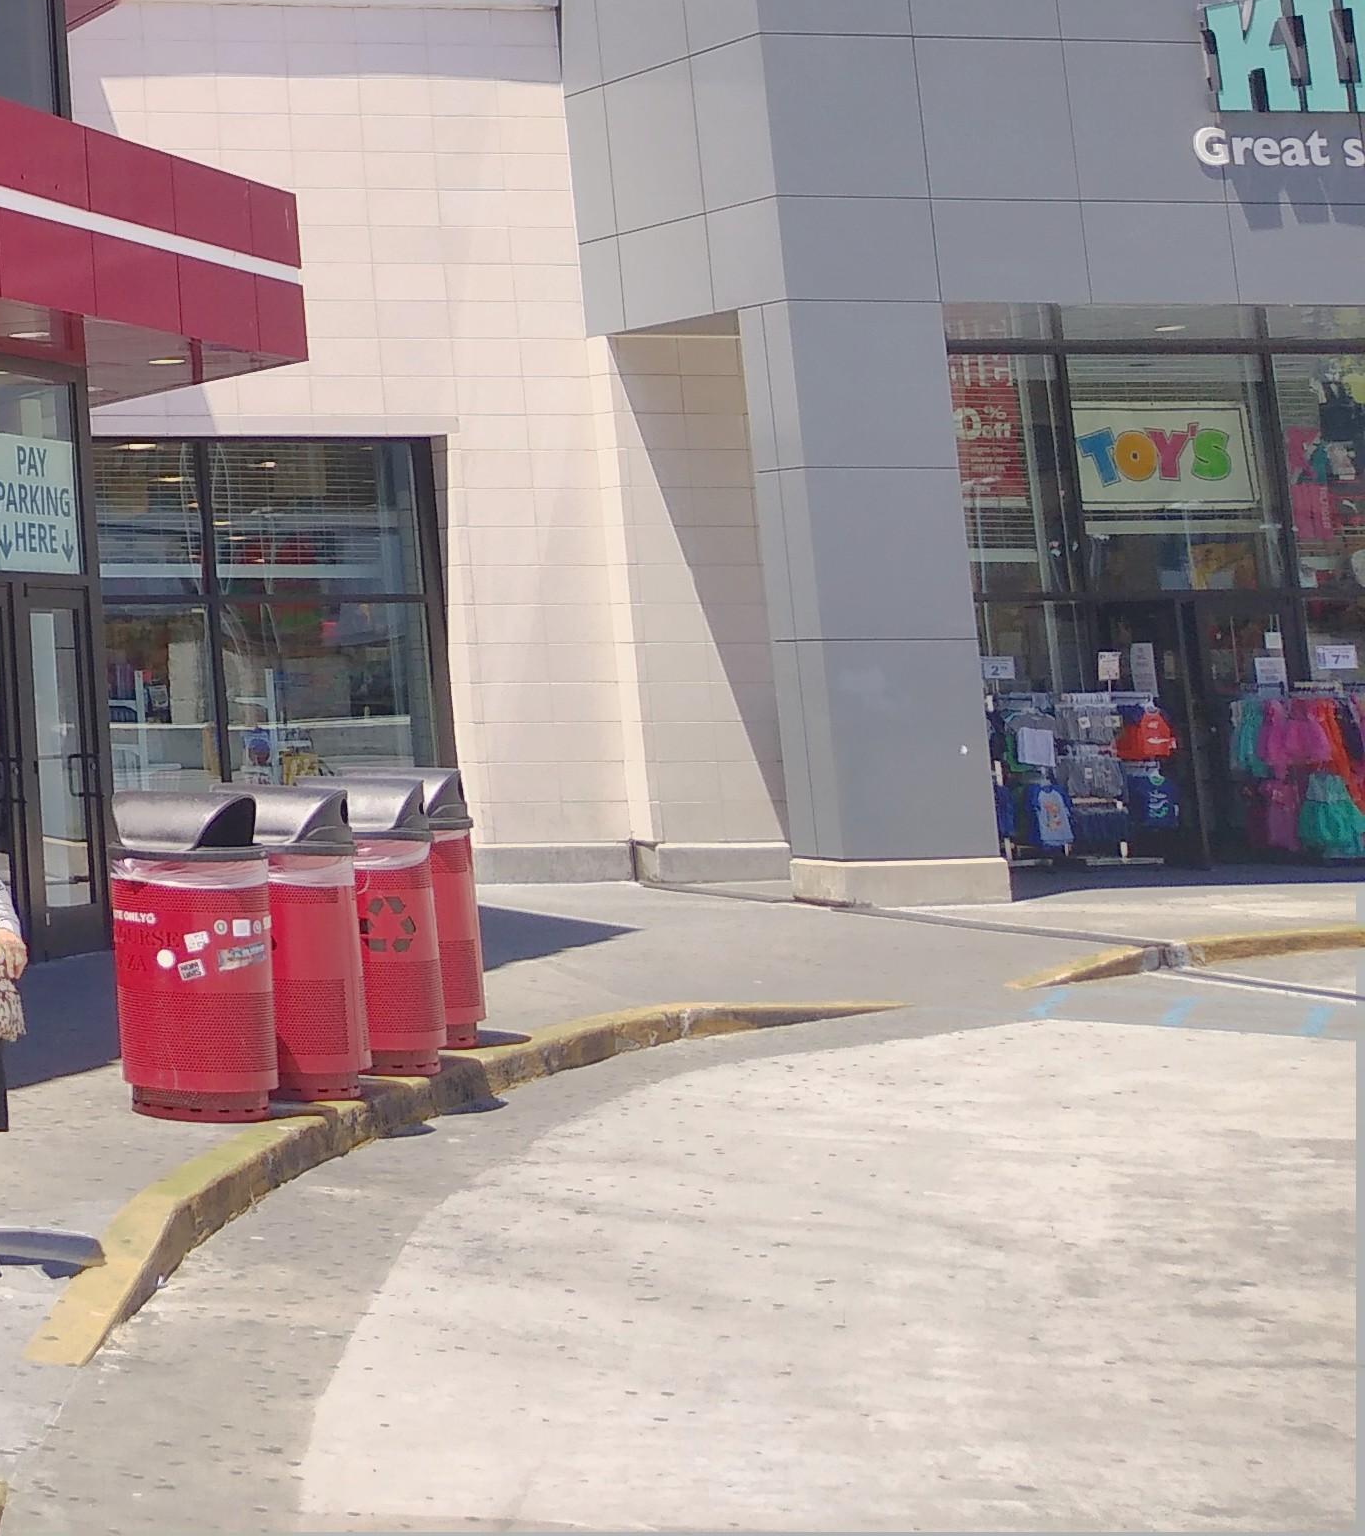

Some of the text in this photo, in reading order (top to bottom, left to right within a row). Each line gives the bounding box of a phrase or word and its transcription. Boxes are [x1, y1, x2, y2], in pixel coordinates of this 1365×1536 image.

[1193, 126, 1330, 166] Great
[16, 445, 47, 478] PAY
[1076, 422, 1232, 487] TOY'S
[15, 521, 58, 554] HERE
